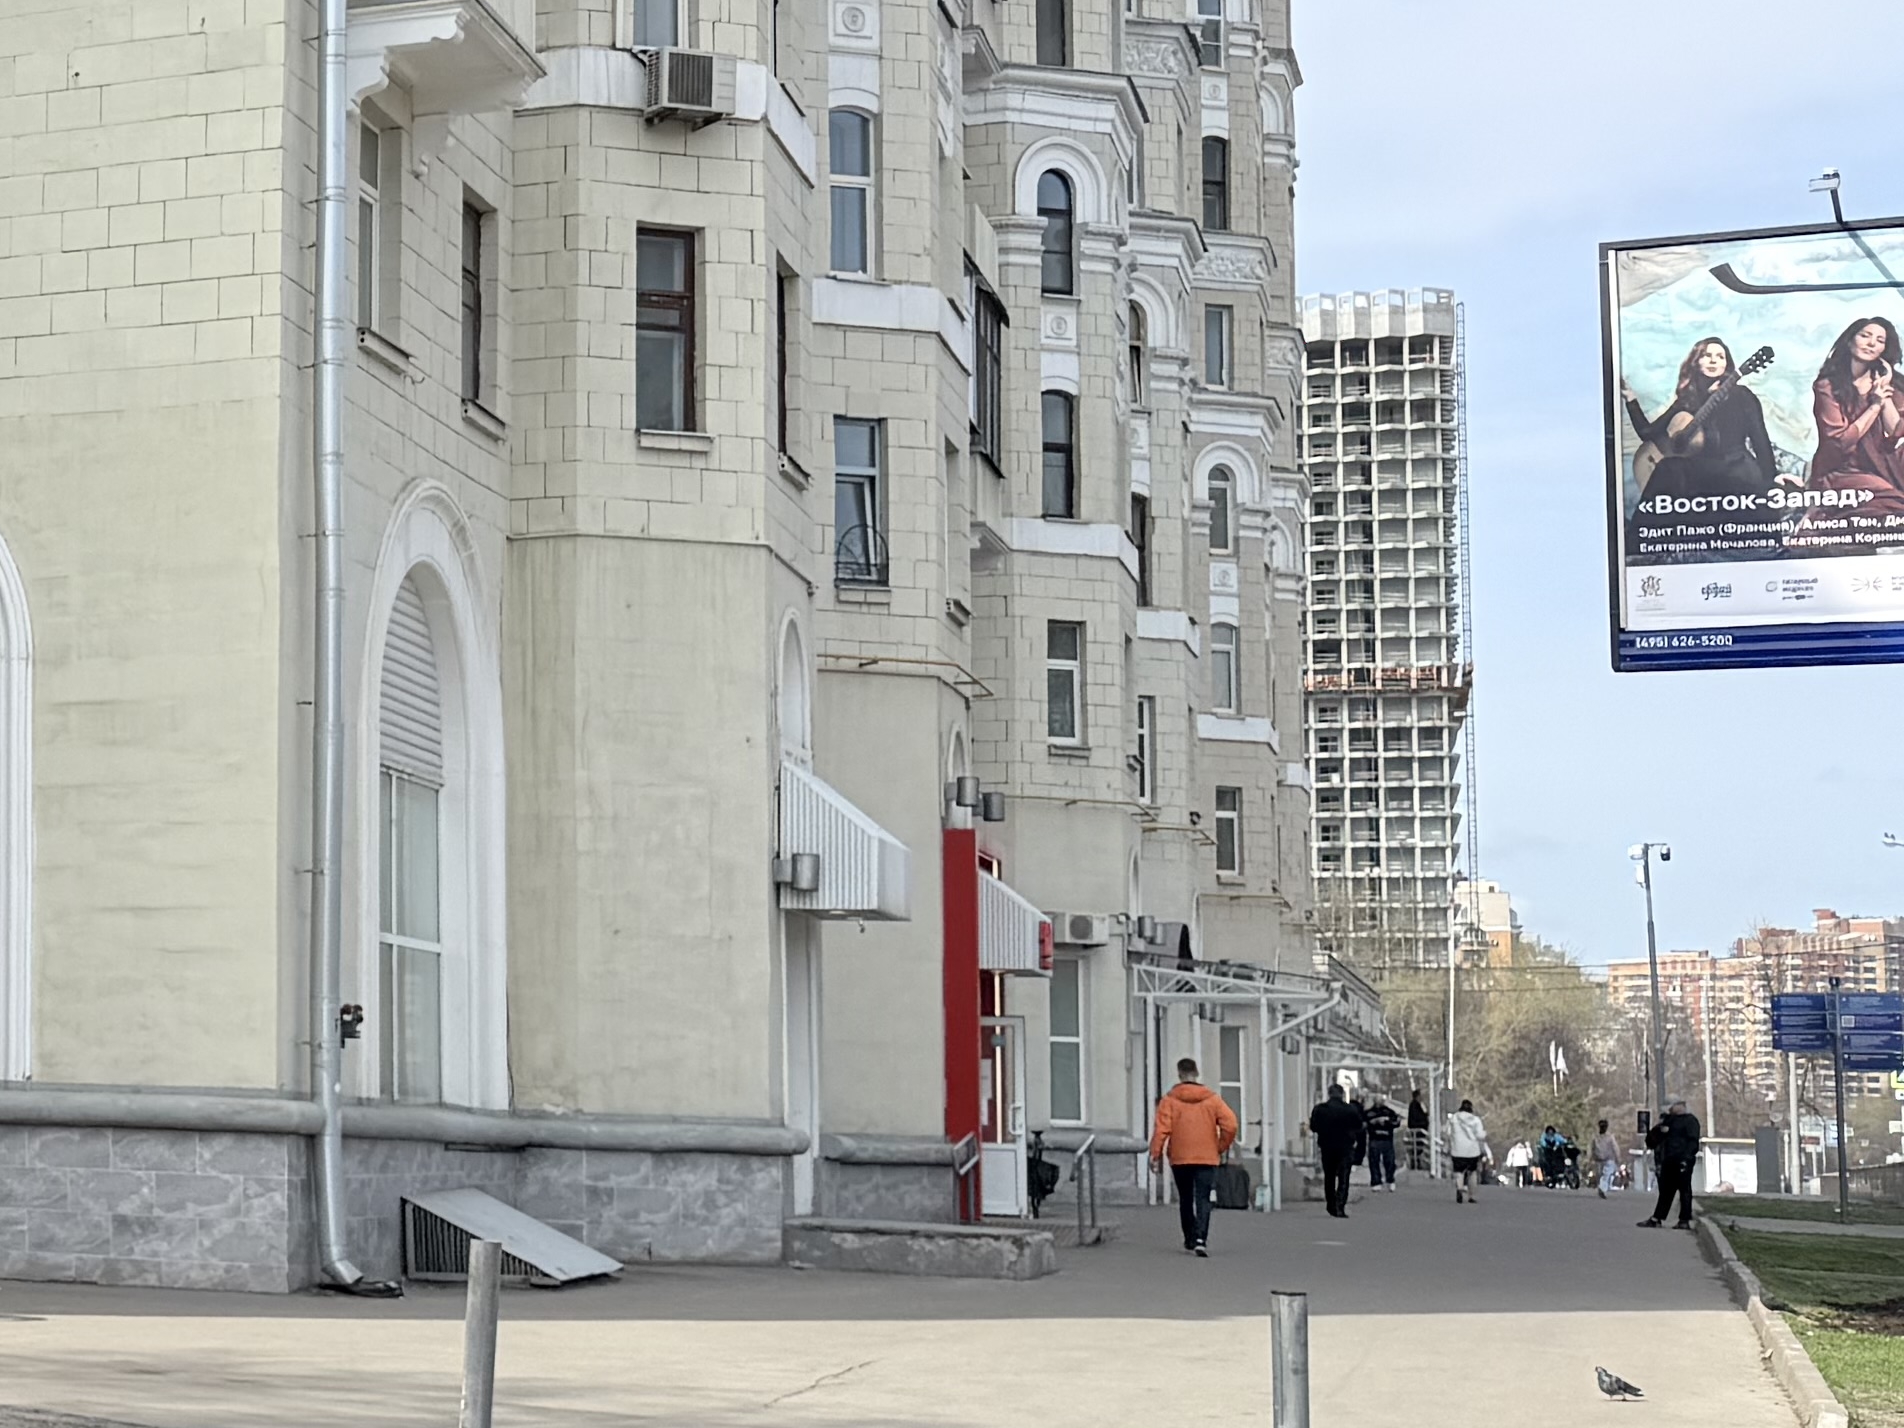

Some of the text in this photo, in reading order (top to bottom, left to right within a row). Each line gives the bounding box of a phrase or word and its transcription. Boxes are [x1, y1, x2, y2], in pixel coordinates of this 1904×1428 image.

[1638, 487, 1875, 514] «Восток-Запад»
[1638, 527, 1673, 539] Эдит
[1802, 517, 1848, 530] Алиса
[1639, 541, 1707, 553] Екатерина
[1782, 534, 1852, 547] Екатерина
[1671, 635, 1733, 647] 626-5200
